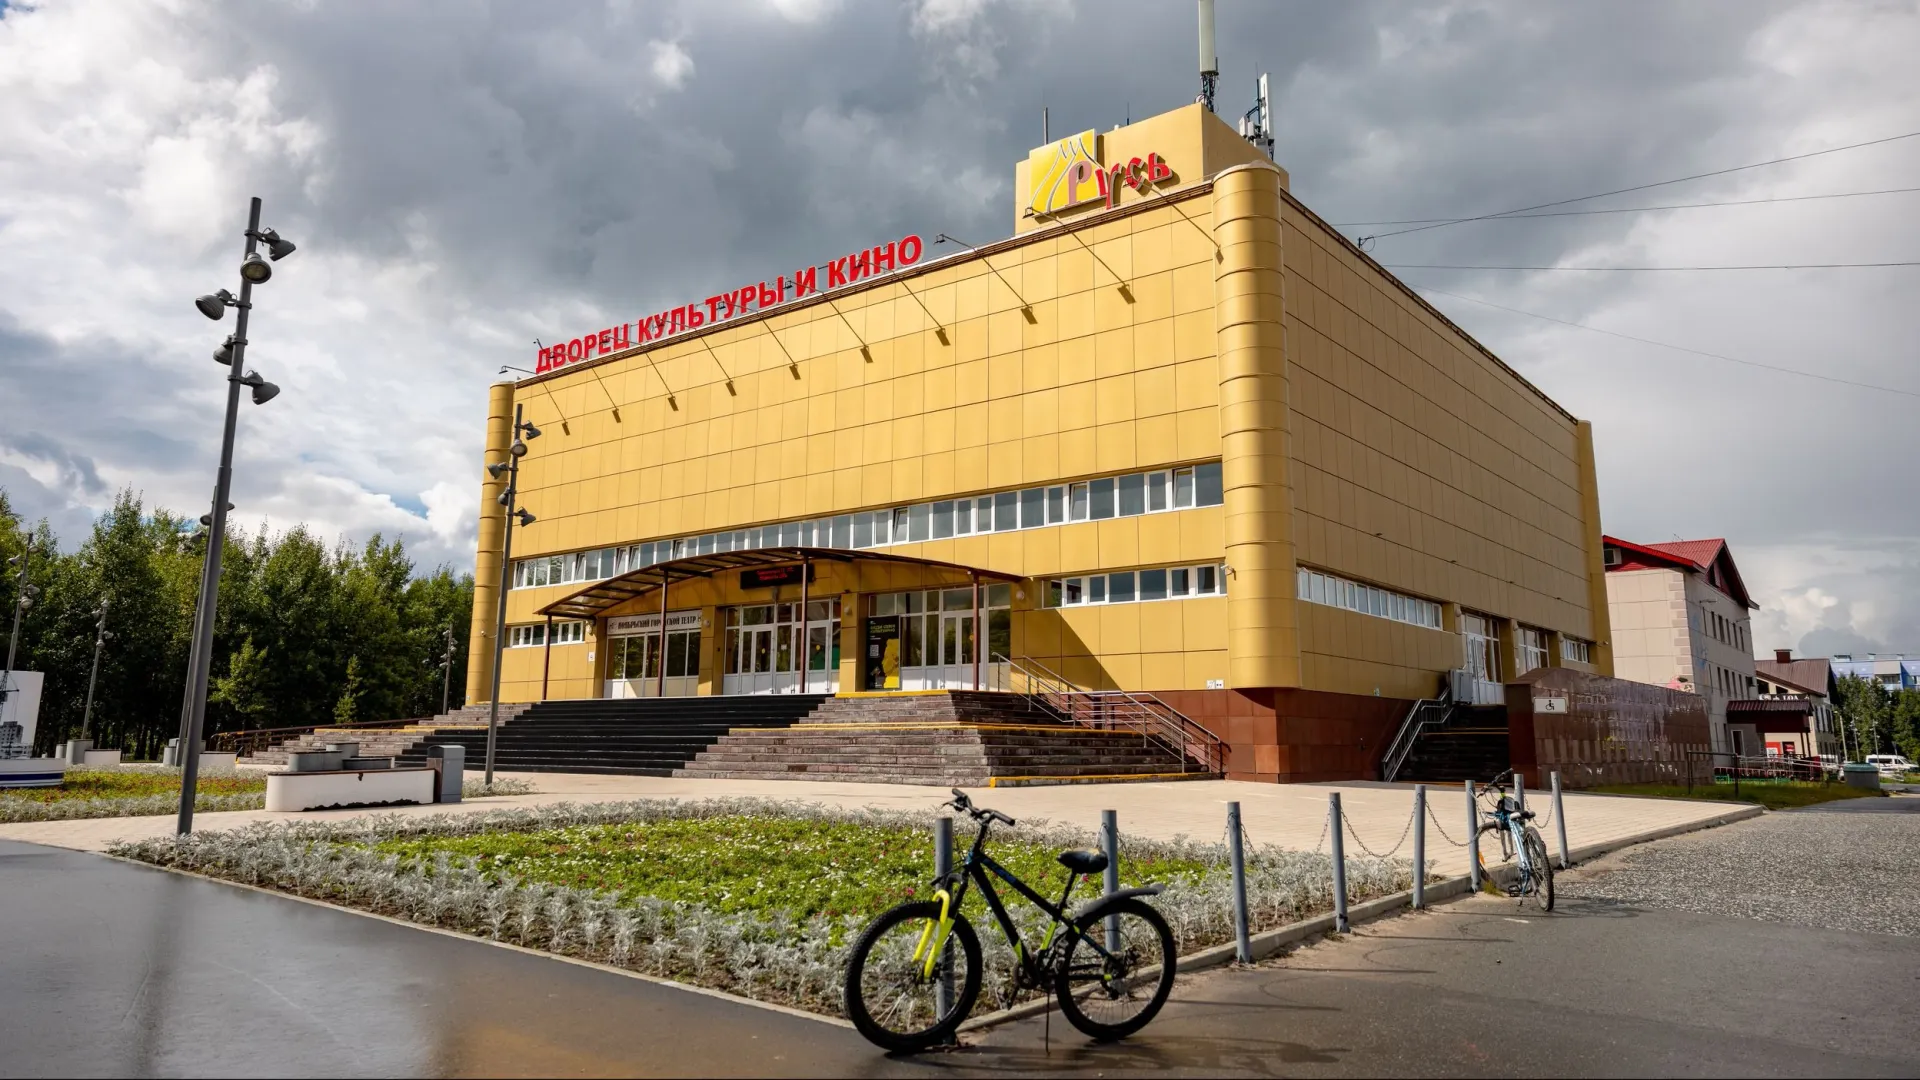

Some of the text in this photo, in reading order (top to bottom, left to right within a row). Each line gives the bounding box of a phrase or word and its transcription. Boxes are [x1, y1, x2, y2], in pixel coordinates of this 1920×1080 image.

[1068, 152, 1173, 210] Русь
[535, 233, 924, 374] ДВОРЕЦ КУЛЬТУРЫ И КИНО
